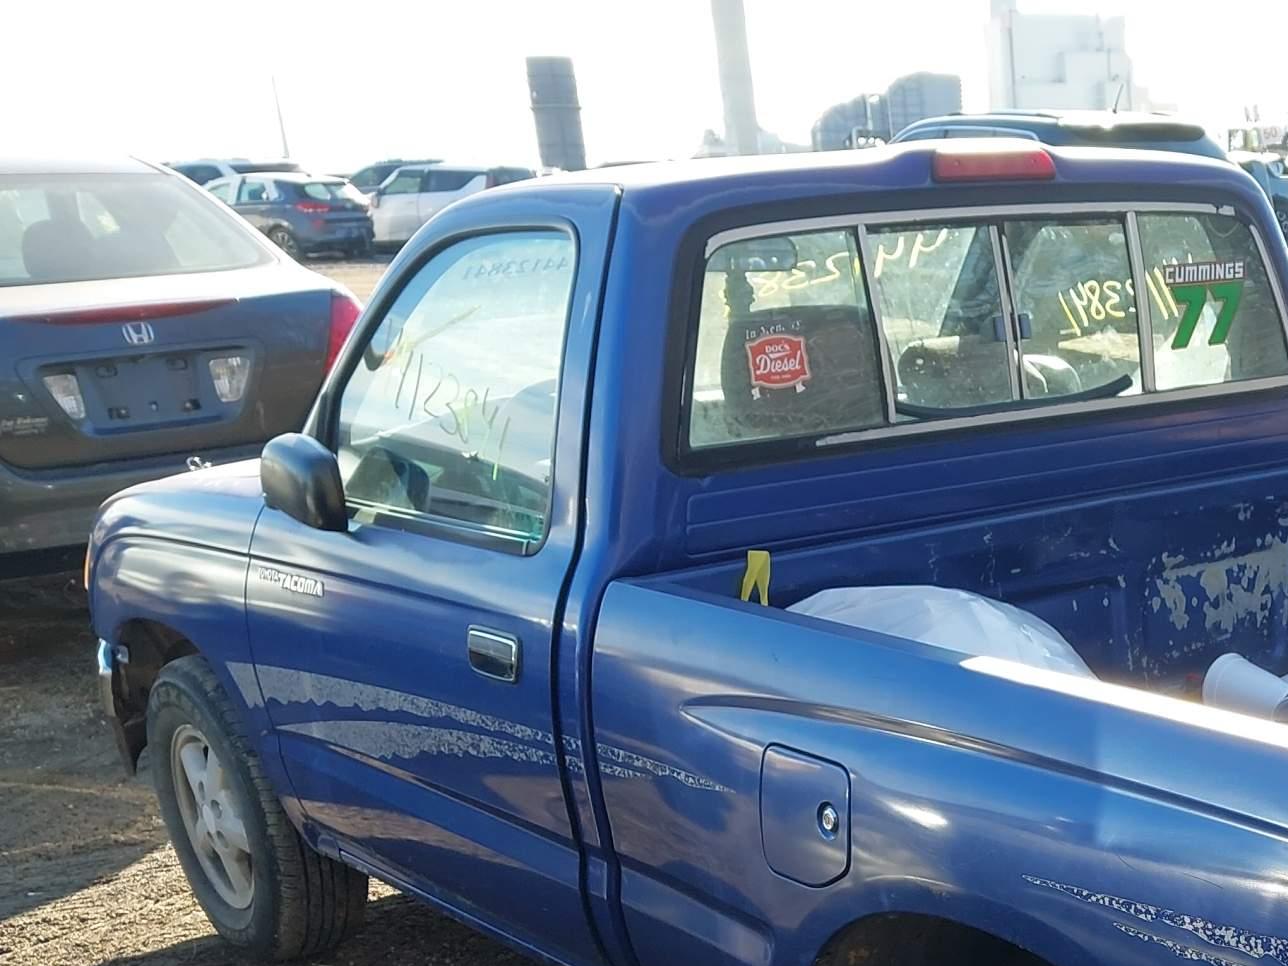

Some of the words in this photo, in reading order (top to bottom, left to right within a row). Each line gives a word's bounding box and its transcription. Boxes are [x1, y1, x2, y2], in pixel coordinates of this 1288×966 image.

[1165, 261, 1244, 284] CUMMINGS
[1170, 279, 1244, 350] 77
[755, 350, 802, 375] Diesel
[278, 573, 325, 598] TACOMA
